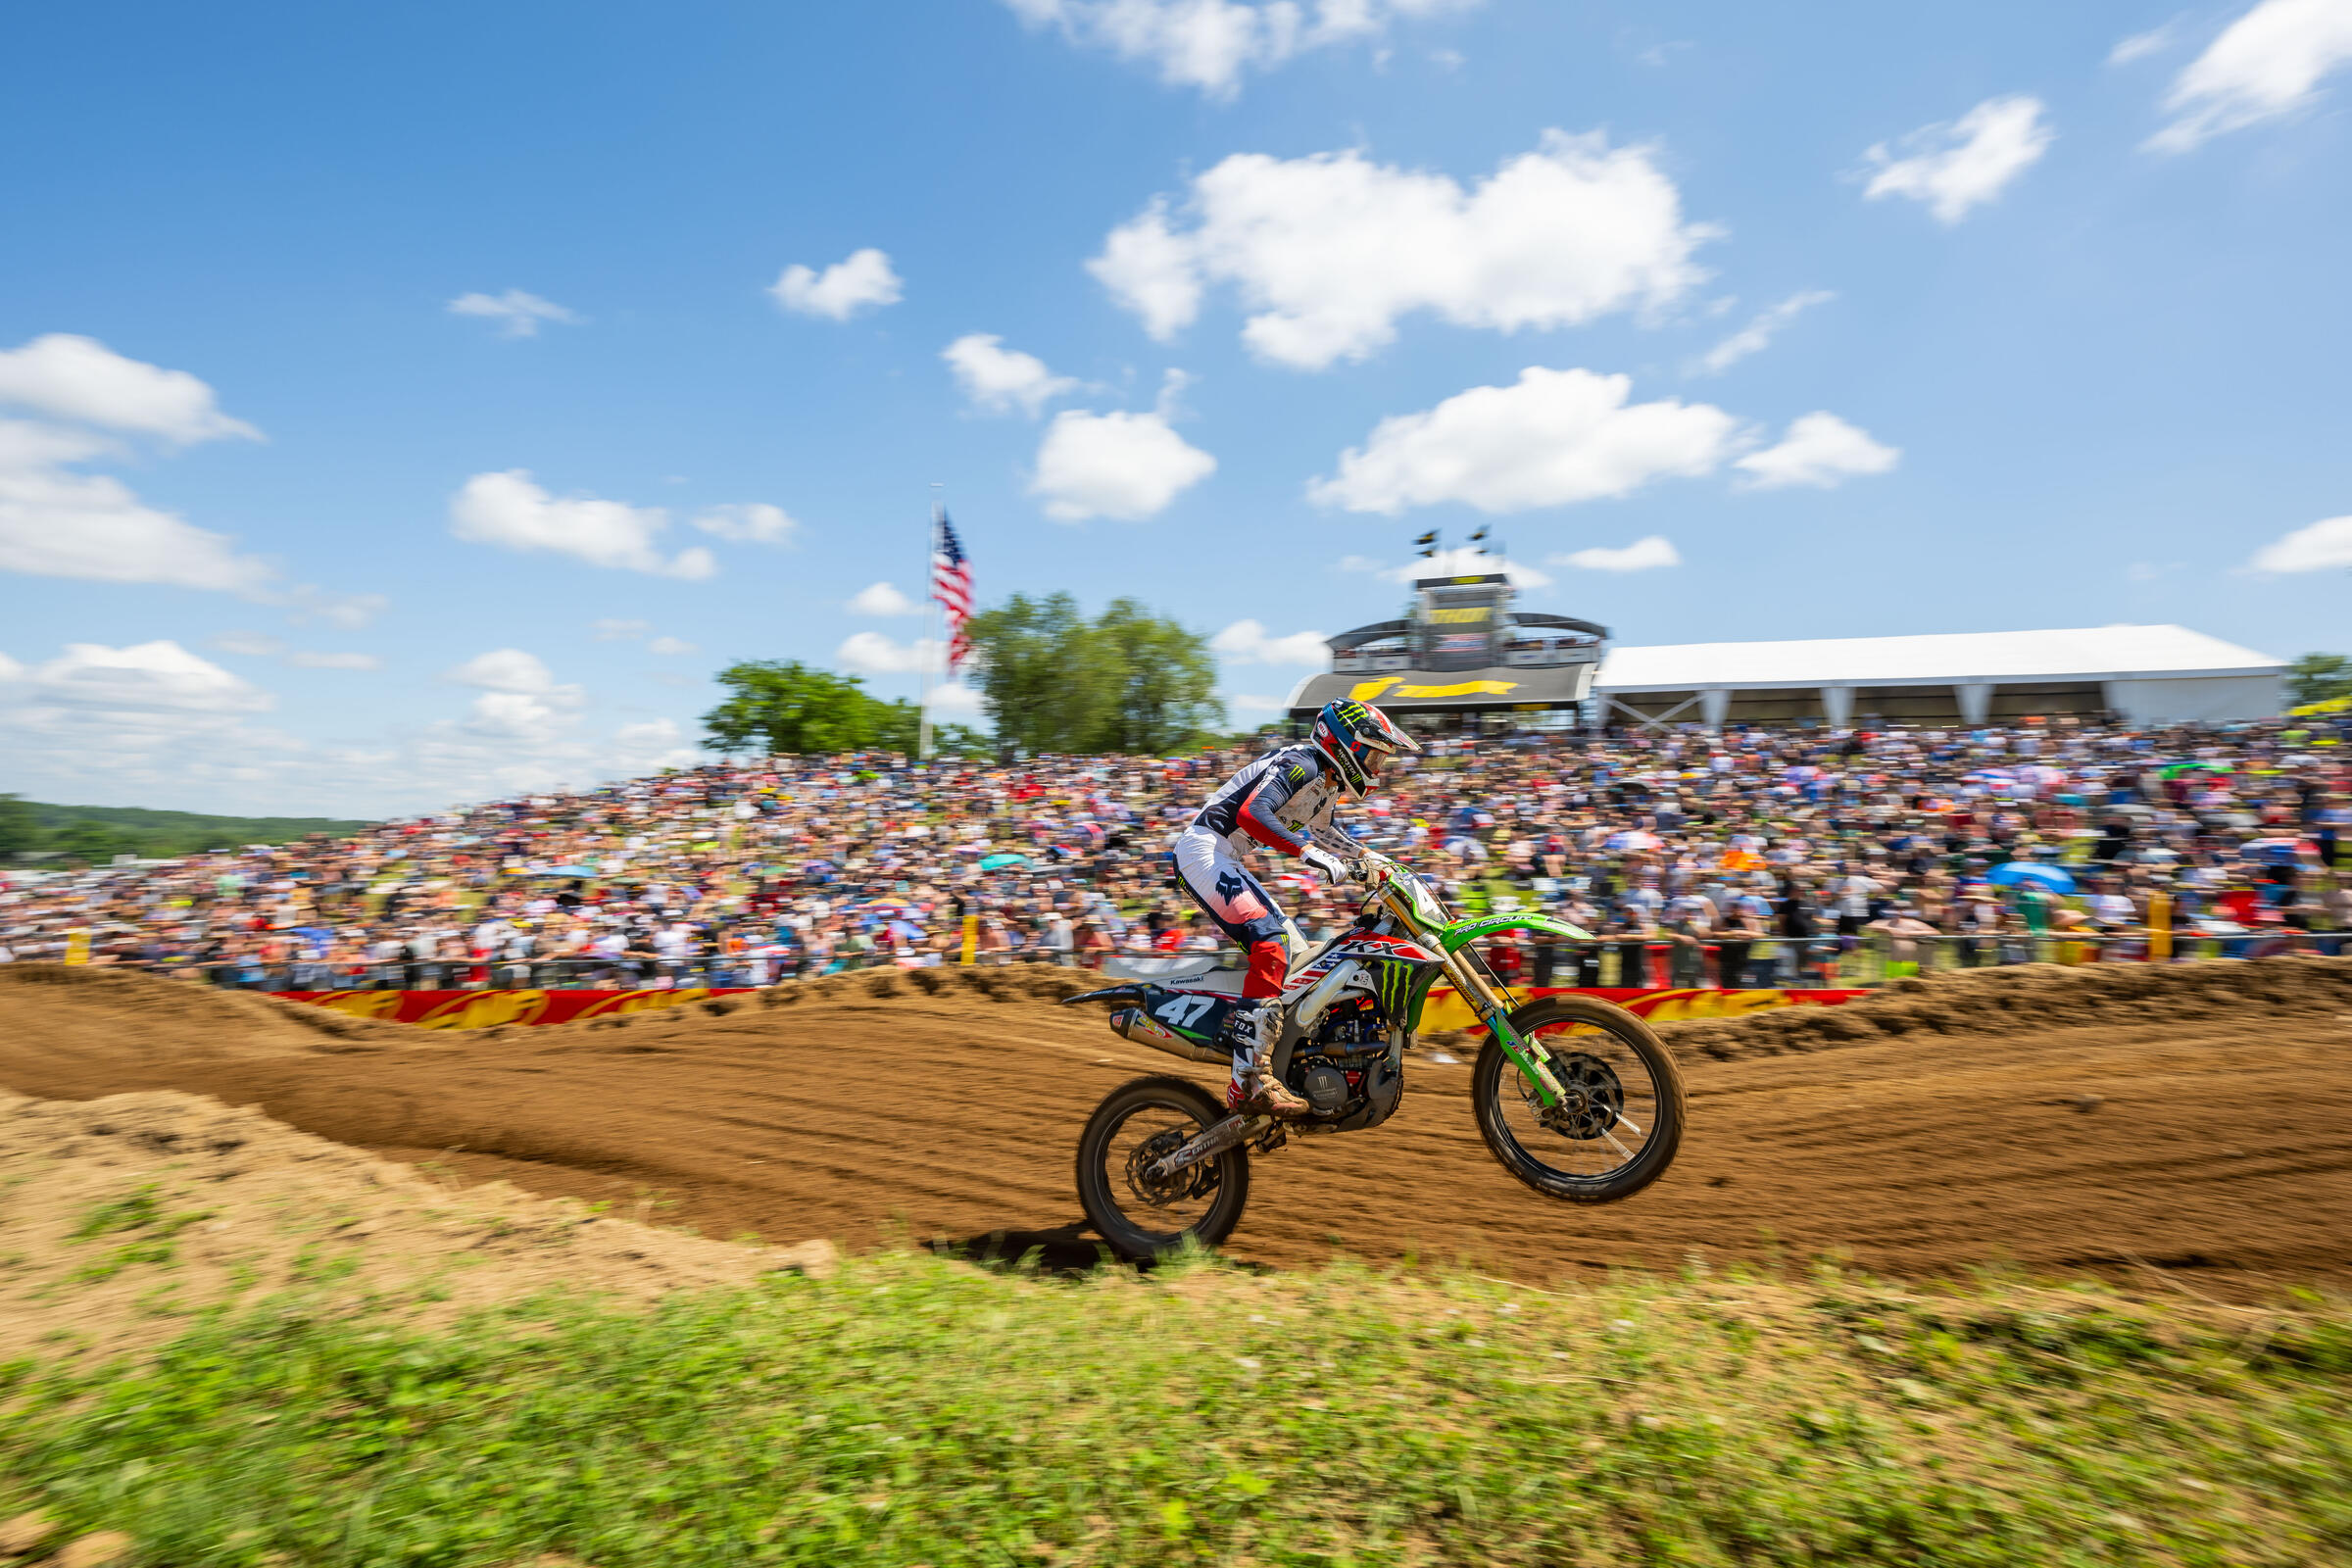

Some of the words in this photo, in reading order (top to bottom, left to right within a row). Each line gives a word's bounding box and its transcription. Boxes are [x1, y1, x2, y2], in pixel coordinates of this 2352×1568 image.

[1315, 849, 1339, 864] FOX
[1454, 921, 1478, 938] PRO
[1478, 915, 1533, 929] CIRCUIT
[1340, 939, 1414, 956] KX
[1170, 975, 1204, 985] Kawasaki
[1154, 995, 1216, 1028] 47
[1234, 1019, 1253, 1034] FOX
[1175, 1136, 1221, 1167] RENTHA
